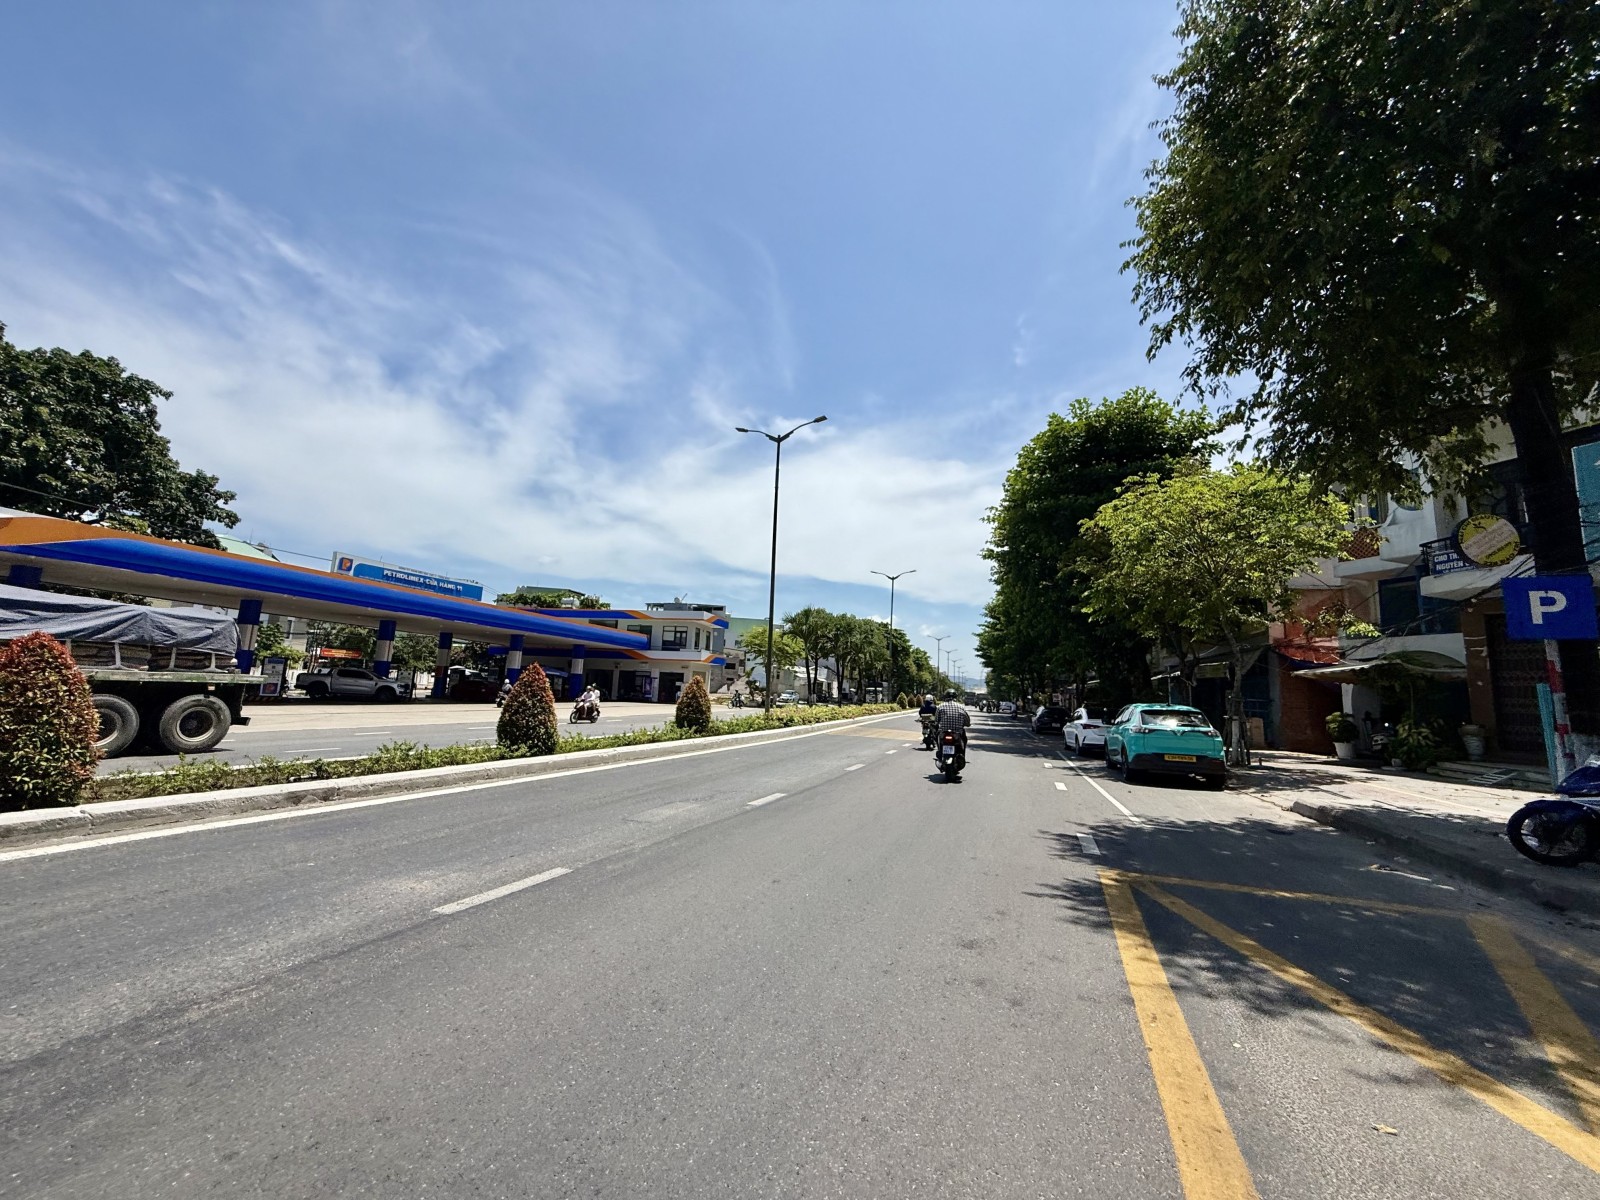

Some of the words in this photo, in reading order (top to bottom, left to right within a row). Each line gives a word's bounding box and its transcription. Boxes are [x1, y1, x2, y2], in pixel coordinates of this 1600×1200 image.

[1434, 554, 1448, 562] CHO
[439, 581, 456, 591] HÀNG
[1528, 590, 1567, 625] P
